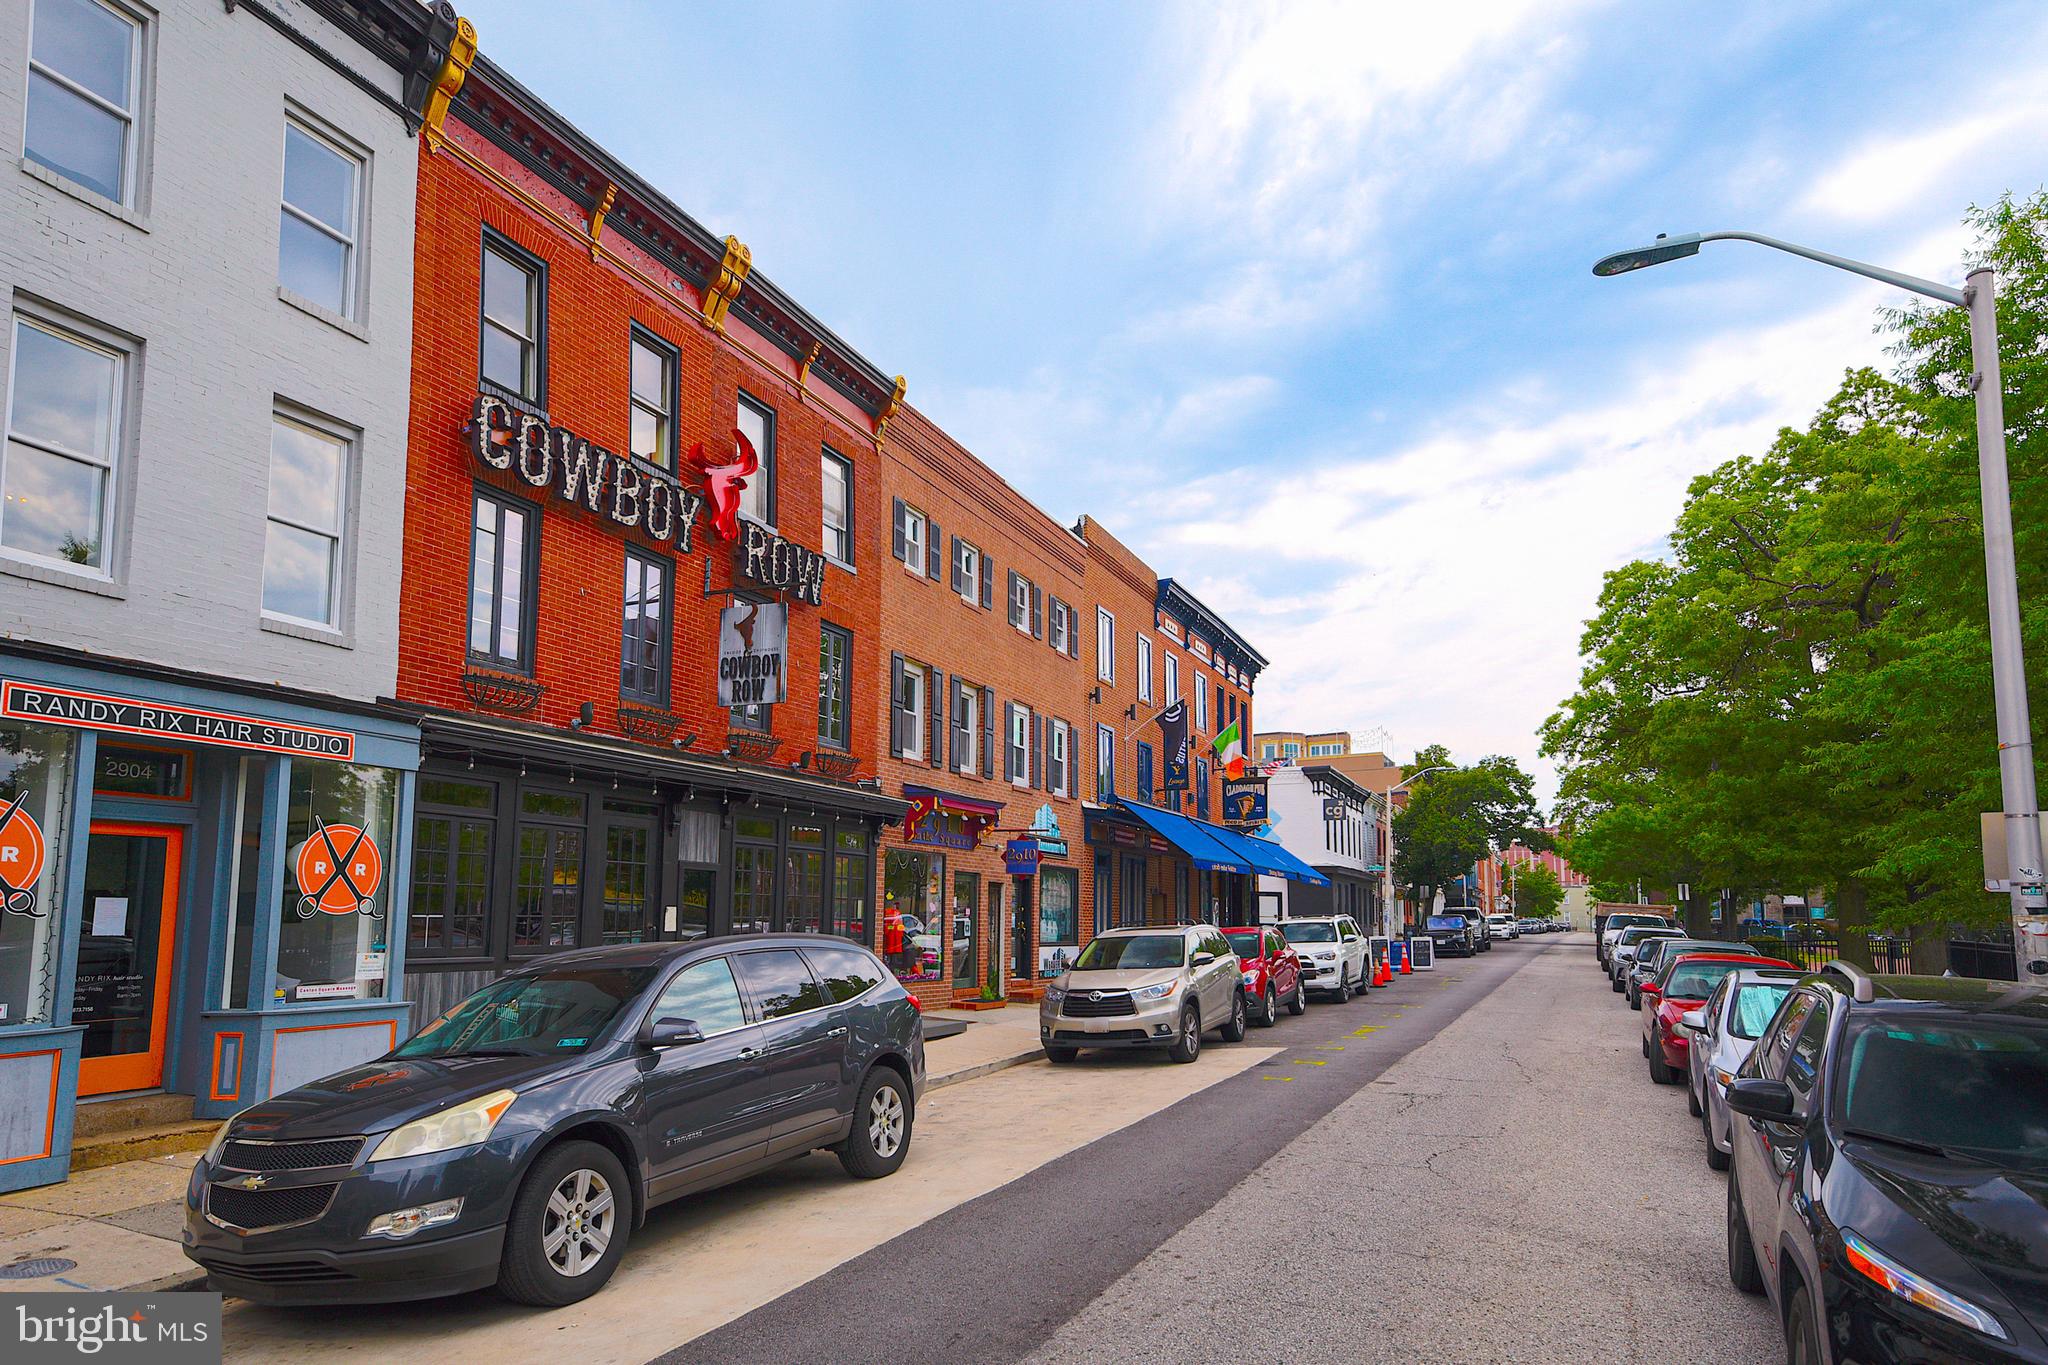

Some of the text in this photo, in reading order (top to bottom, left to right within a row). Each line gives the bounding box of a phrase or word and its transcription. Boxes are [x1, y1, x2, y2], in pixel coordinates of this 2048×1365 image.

[474, 394, 825, 605] COWBOY ROW
[720, 654, 781, 680] COWBOY
[731, 679, 766, 703] ROW
[23, 692, 343, 754] RANDY RIX HAIR STUDIO
[105, 761, 153, 780] 2904
[1007, 847, 1037, 864] 2910
[314, 861, 367, 877] R R
[77, 975, 96, 983] NDY
